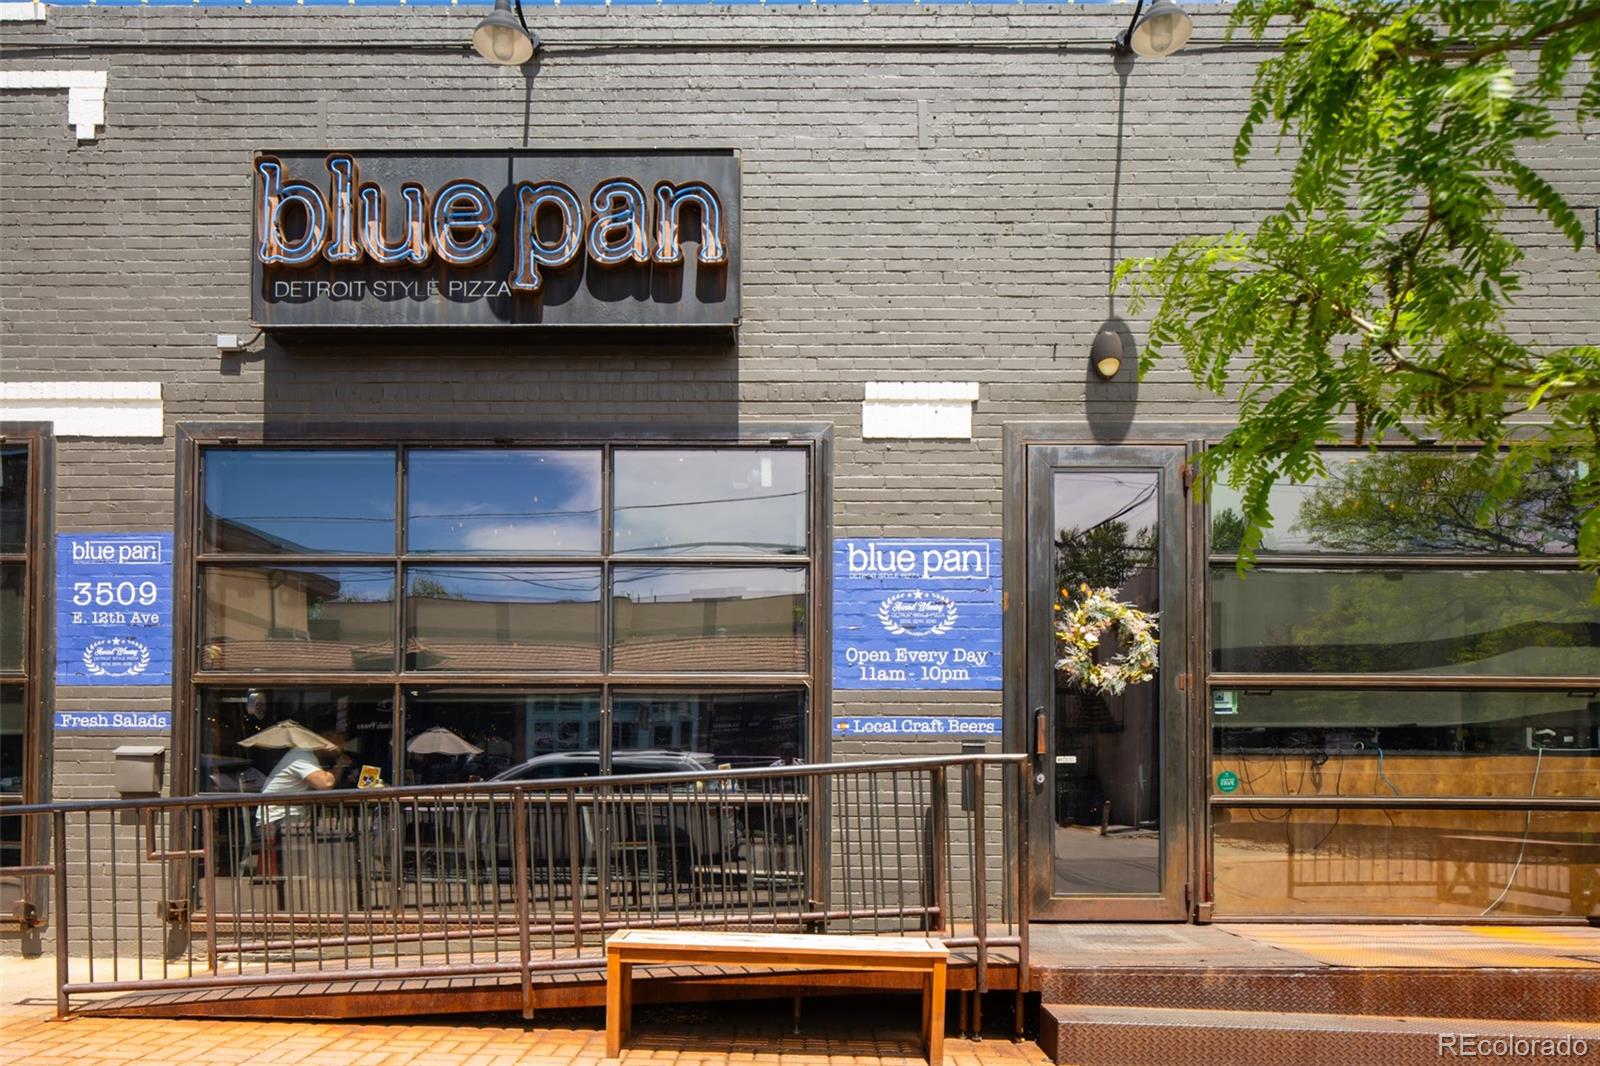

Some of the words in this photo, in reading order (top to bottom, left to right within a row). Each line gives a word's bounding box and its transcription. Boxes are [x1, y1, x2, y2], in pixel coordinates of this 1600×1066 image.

[255, 152, 497, 266] blue
[513, 176, 728, 291] pan
[275, 281, 367, 298] DETROIT
[373, 280, 439, 298] STYLE
[449, 280, 511, 297] PIZZA
[72, 541, 115, 560] blue
[119, 545, 157, 564] pan
[847, 543, 915, 572] blue
[923, 549, 983, 578] pan
[73, 581, 158, 606] 3509
[72, 612, 87, 624] E.
[92, 612, 125, 624] 12th
[130, 612, 159, 624] Ave
[846, 648, 890, 665] Open
[895, 648, 949, 665] Every
[953, 648, 988, 665] Day
[859, 667, 906, 681] 11am
[921, 667, 970, 683] 10pm
[61, 714, 108, 727] Fresh
[113, 714, 166, 728] Salads
[853, 720, 897, 733] Local
[901, 720, 944, 733] Craft
[948, 720, 995, 733] Beers
